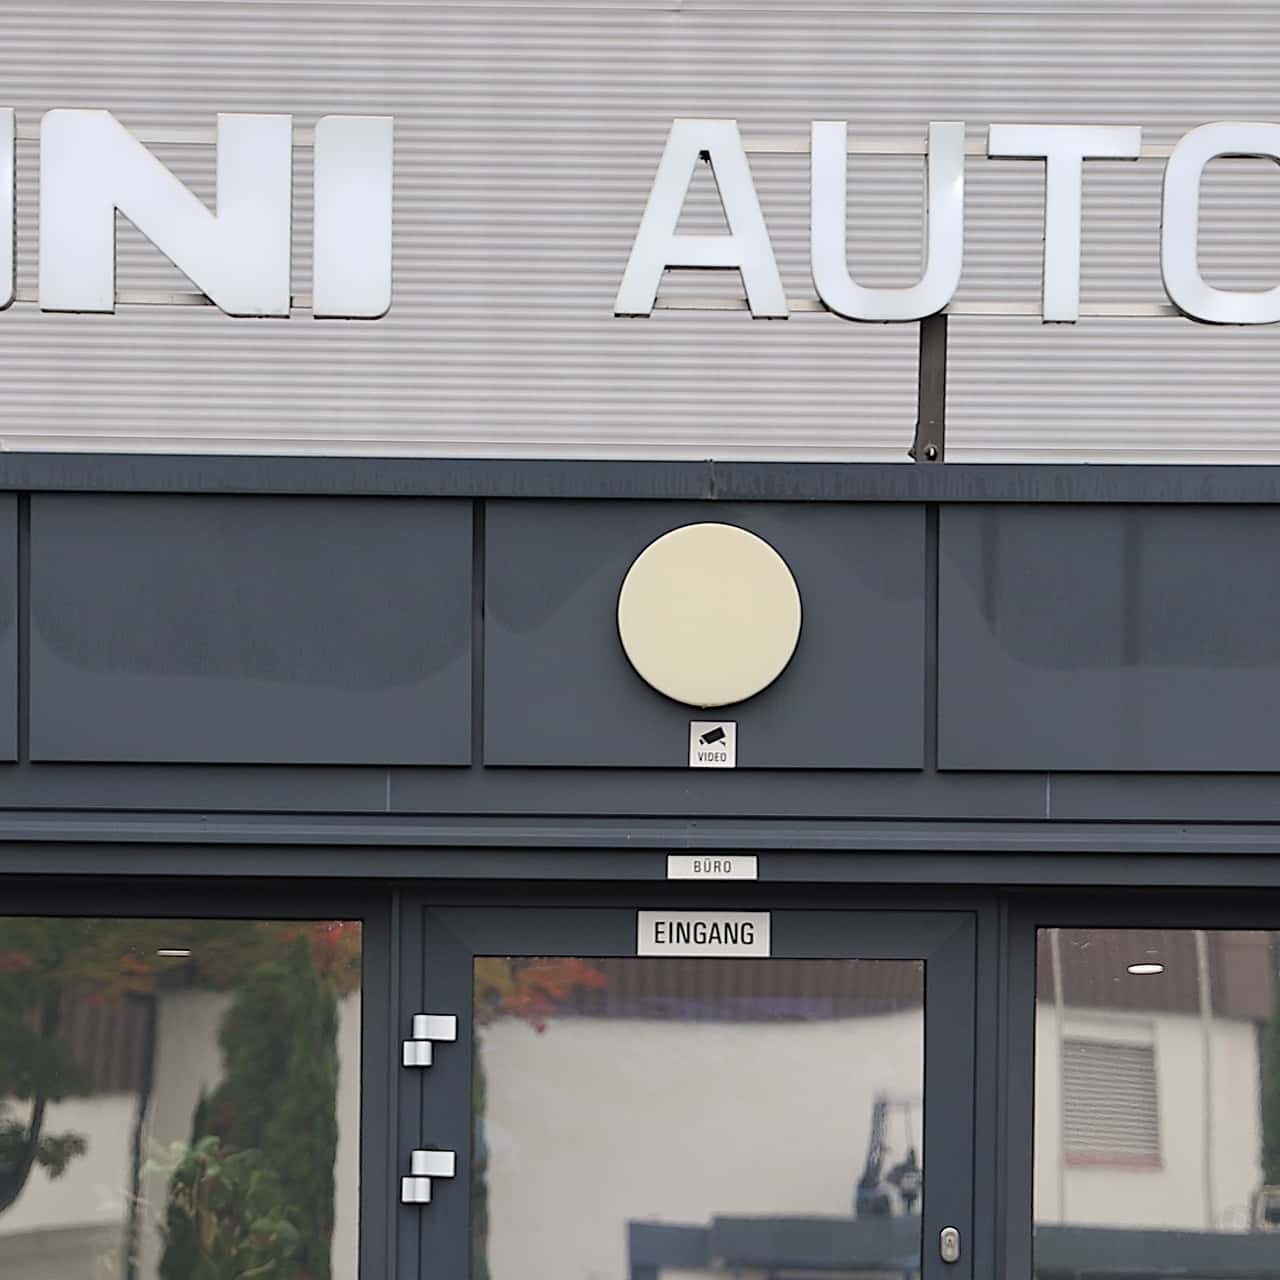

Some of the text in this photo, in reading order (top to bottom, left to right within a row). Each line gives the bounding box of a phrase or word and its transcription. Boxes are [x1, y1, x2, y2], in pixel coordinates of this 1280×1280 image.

[697, 751, 727, 763] VIDEO
[693, 857, 732, 873] BÜRO
[654, 921, 755, 946] EINGANG
